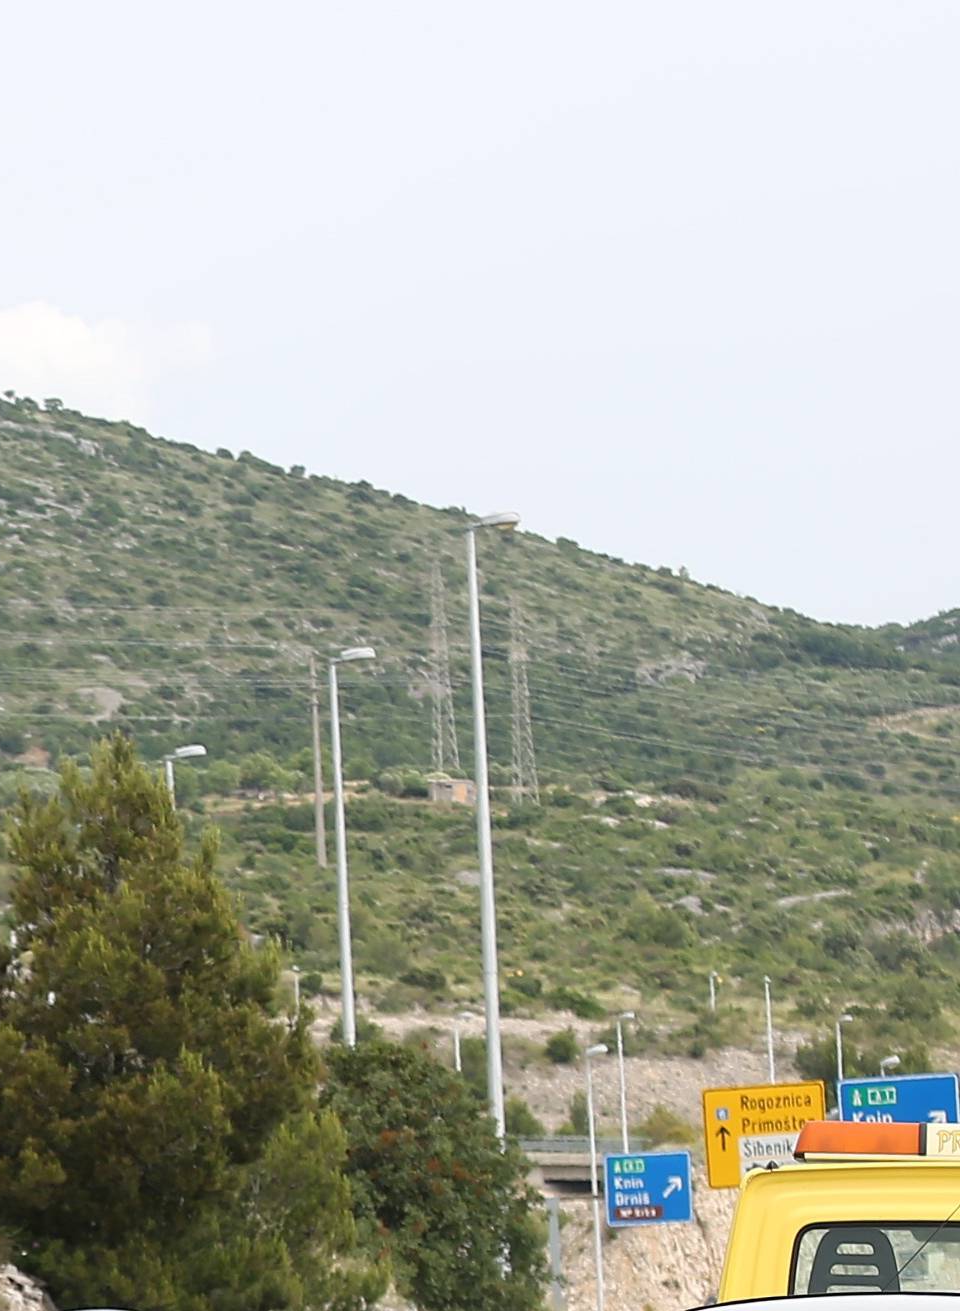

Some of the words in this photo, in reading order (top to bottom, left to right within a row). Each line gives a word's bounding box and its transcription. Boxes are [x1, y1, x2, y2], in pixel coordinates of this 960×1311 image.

[741, 1095, 811, 1113] Rogoznica
[744, 1137, 793, 1157] Šibenik
[614, 1176, 644, 1189] Knin
